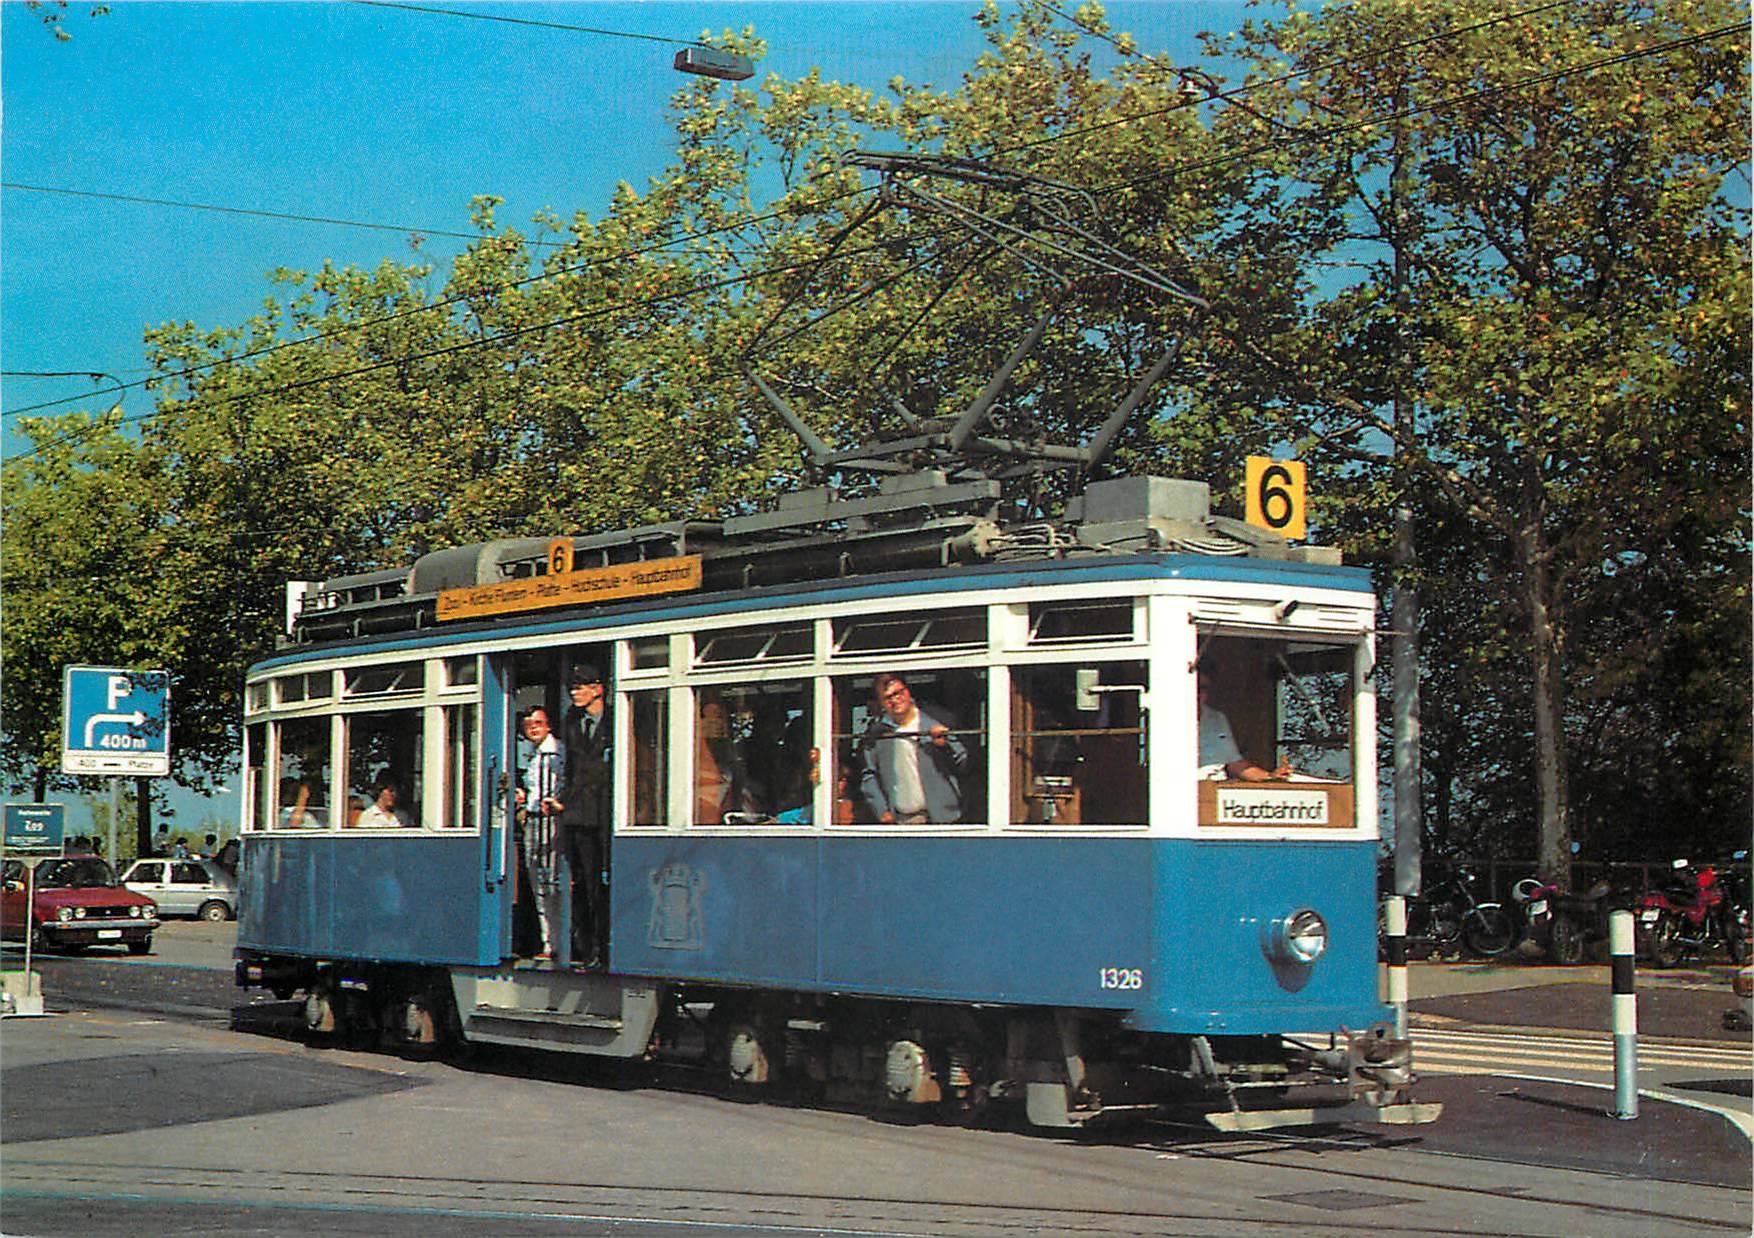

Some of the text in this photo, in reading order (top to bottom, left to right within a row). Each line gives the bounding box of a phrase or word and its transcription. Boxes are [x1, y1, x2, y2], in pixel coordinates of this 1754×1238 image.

[1259, 465, 1293, 529] 6
[553, 546, 565, 573] 6
[107, 675, 132, 711] P
[1223, 798, 1323, 823] Hauptbahnhof
[1100, 967, 1143, 989] 1326
